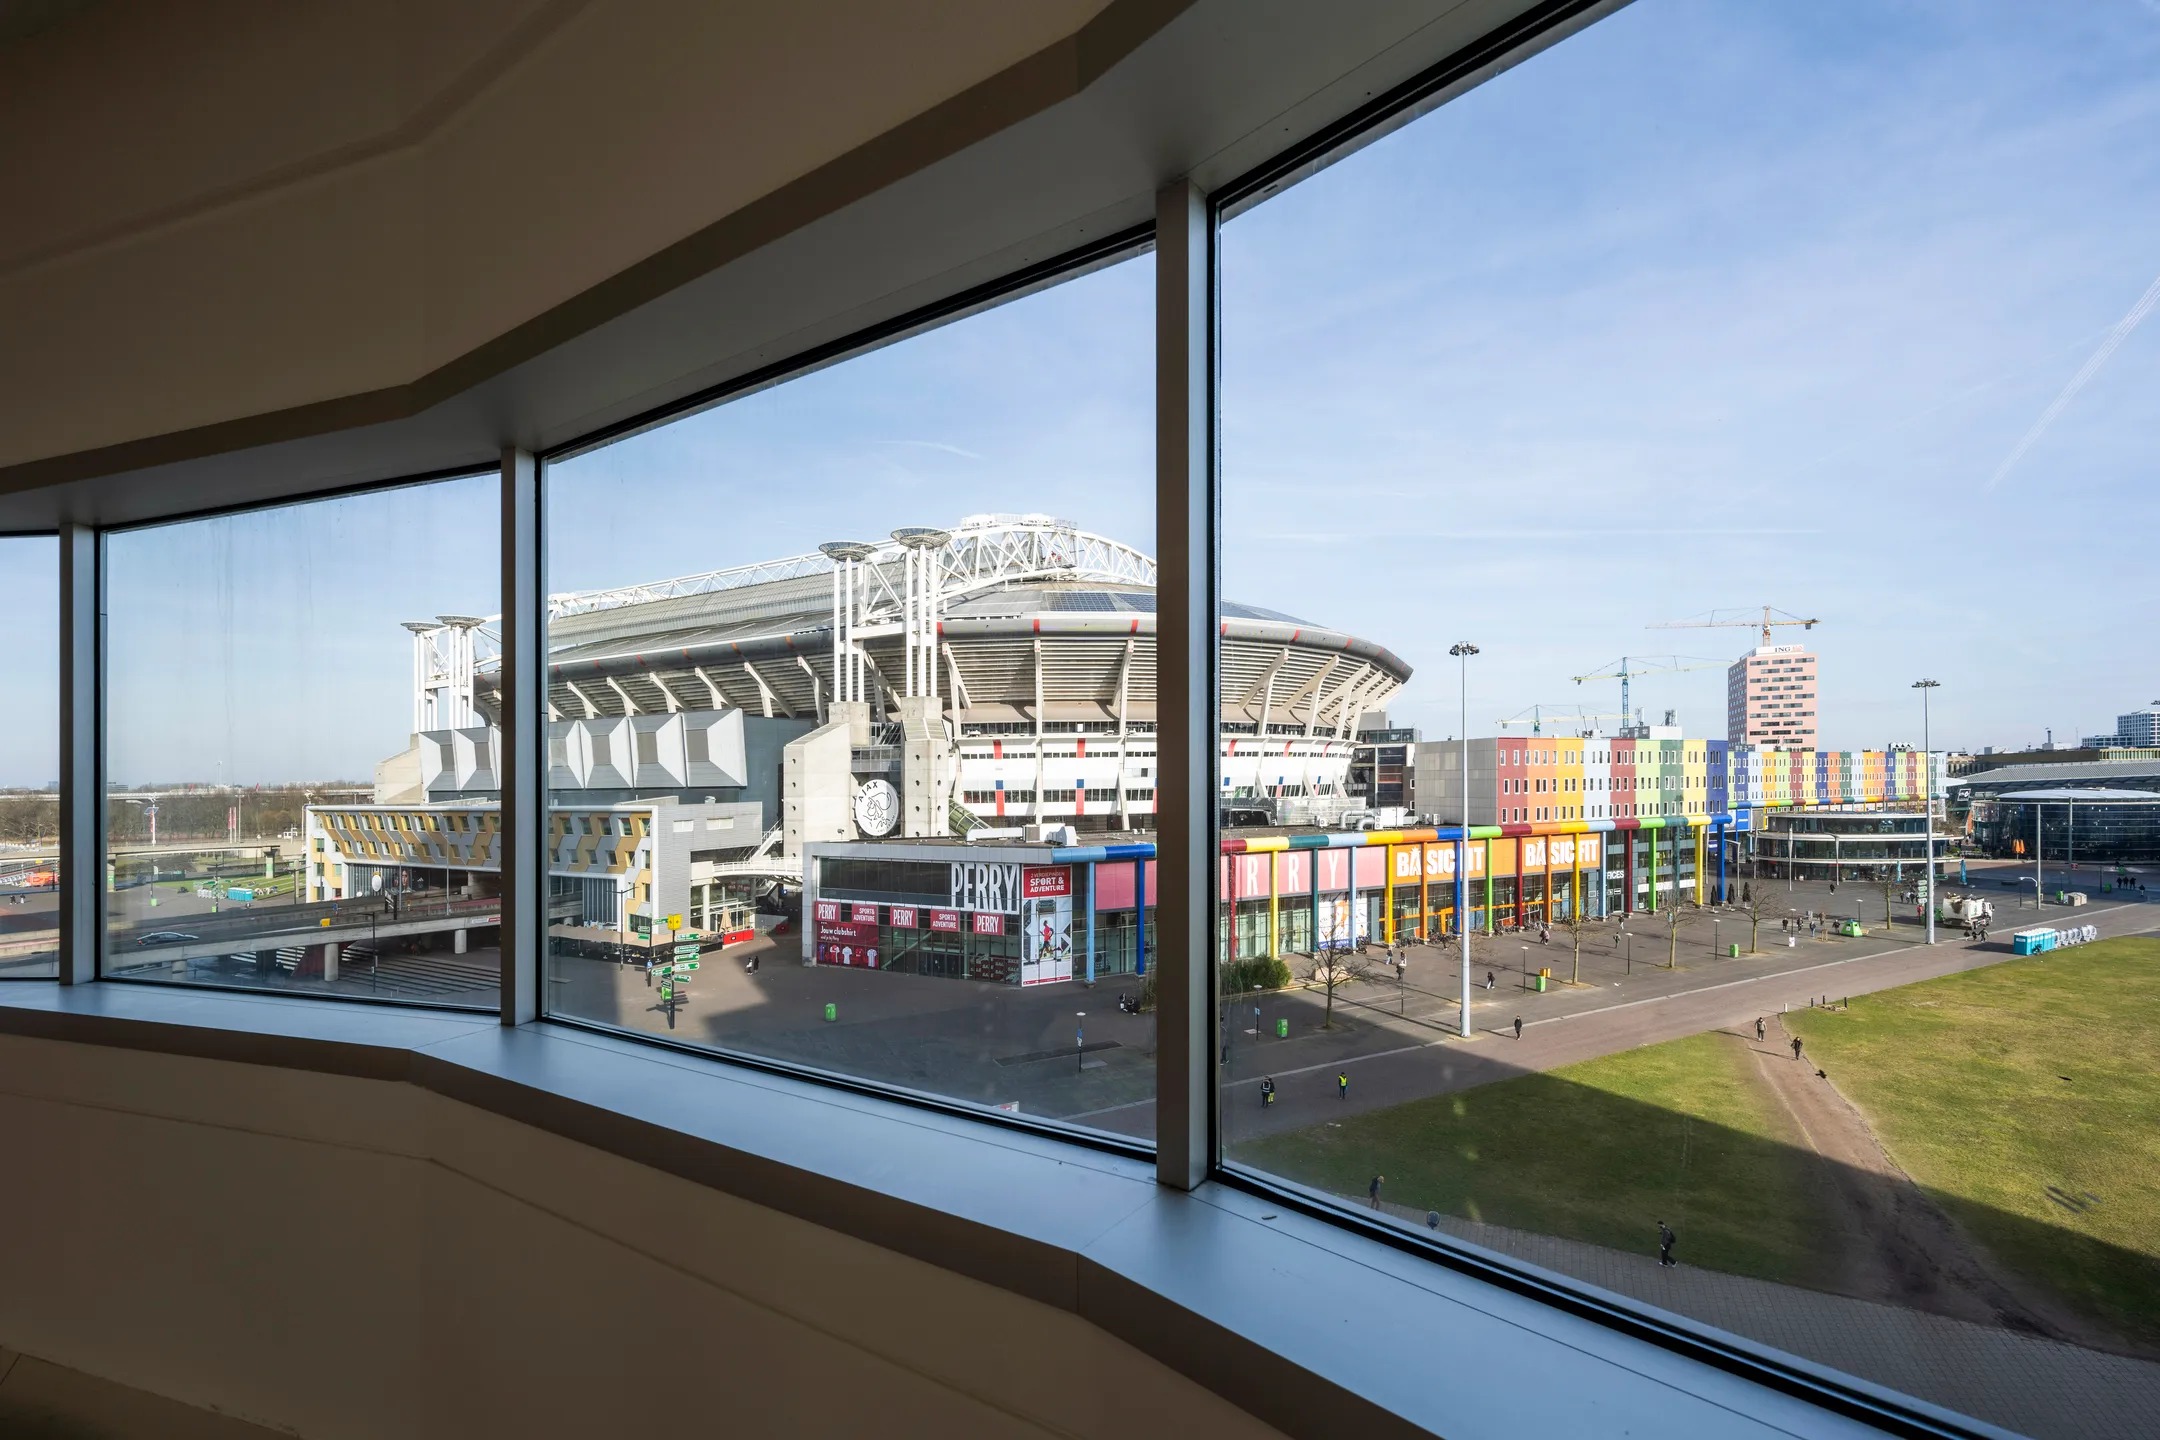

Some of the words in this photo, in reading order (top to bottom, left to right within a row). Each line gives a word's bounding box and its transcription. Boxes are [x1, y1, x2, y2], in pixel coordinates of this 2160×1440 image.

[858, 781, 878, 803] AJAX
[1525, 839, 1574, 867] BASIC
[1396, 847, 1456, 877] BASIC
[1030, 877, 1056, 886] SPORT
[1058, 876, 1065, 885] &
[1247, 851, 1339, 895] RRY
[1607, 870, 1624, 880] FICES
[951, 862, 1019, 914] PERRY
[1030, 885, 1065, 893] ADVENTURE
[818, 903, 837, 920] PERRY
[853, 914, 875, 922] ADVENTURE
[893, 909, 913, 926] PERRY
[820, 925, 834, 934] Jouw
[834, 926, 857, 937] clubshirt
[932, 920, 957, 929] ADVENTURE
[977, 915, 1000, 933] PERRY
